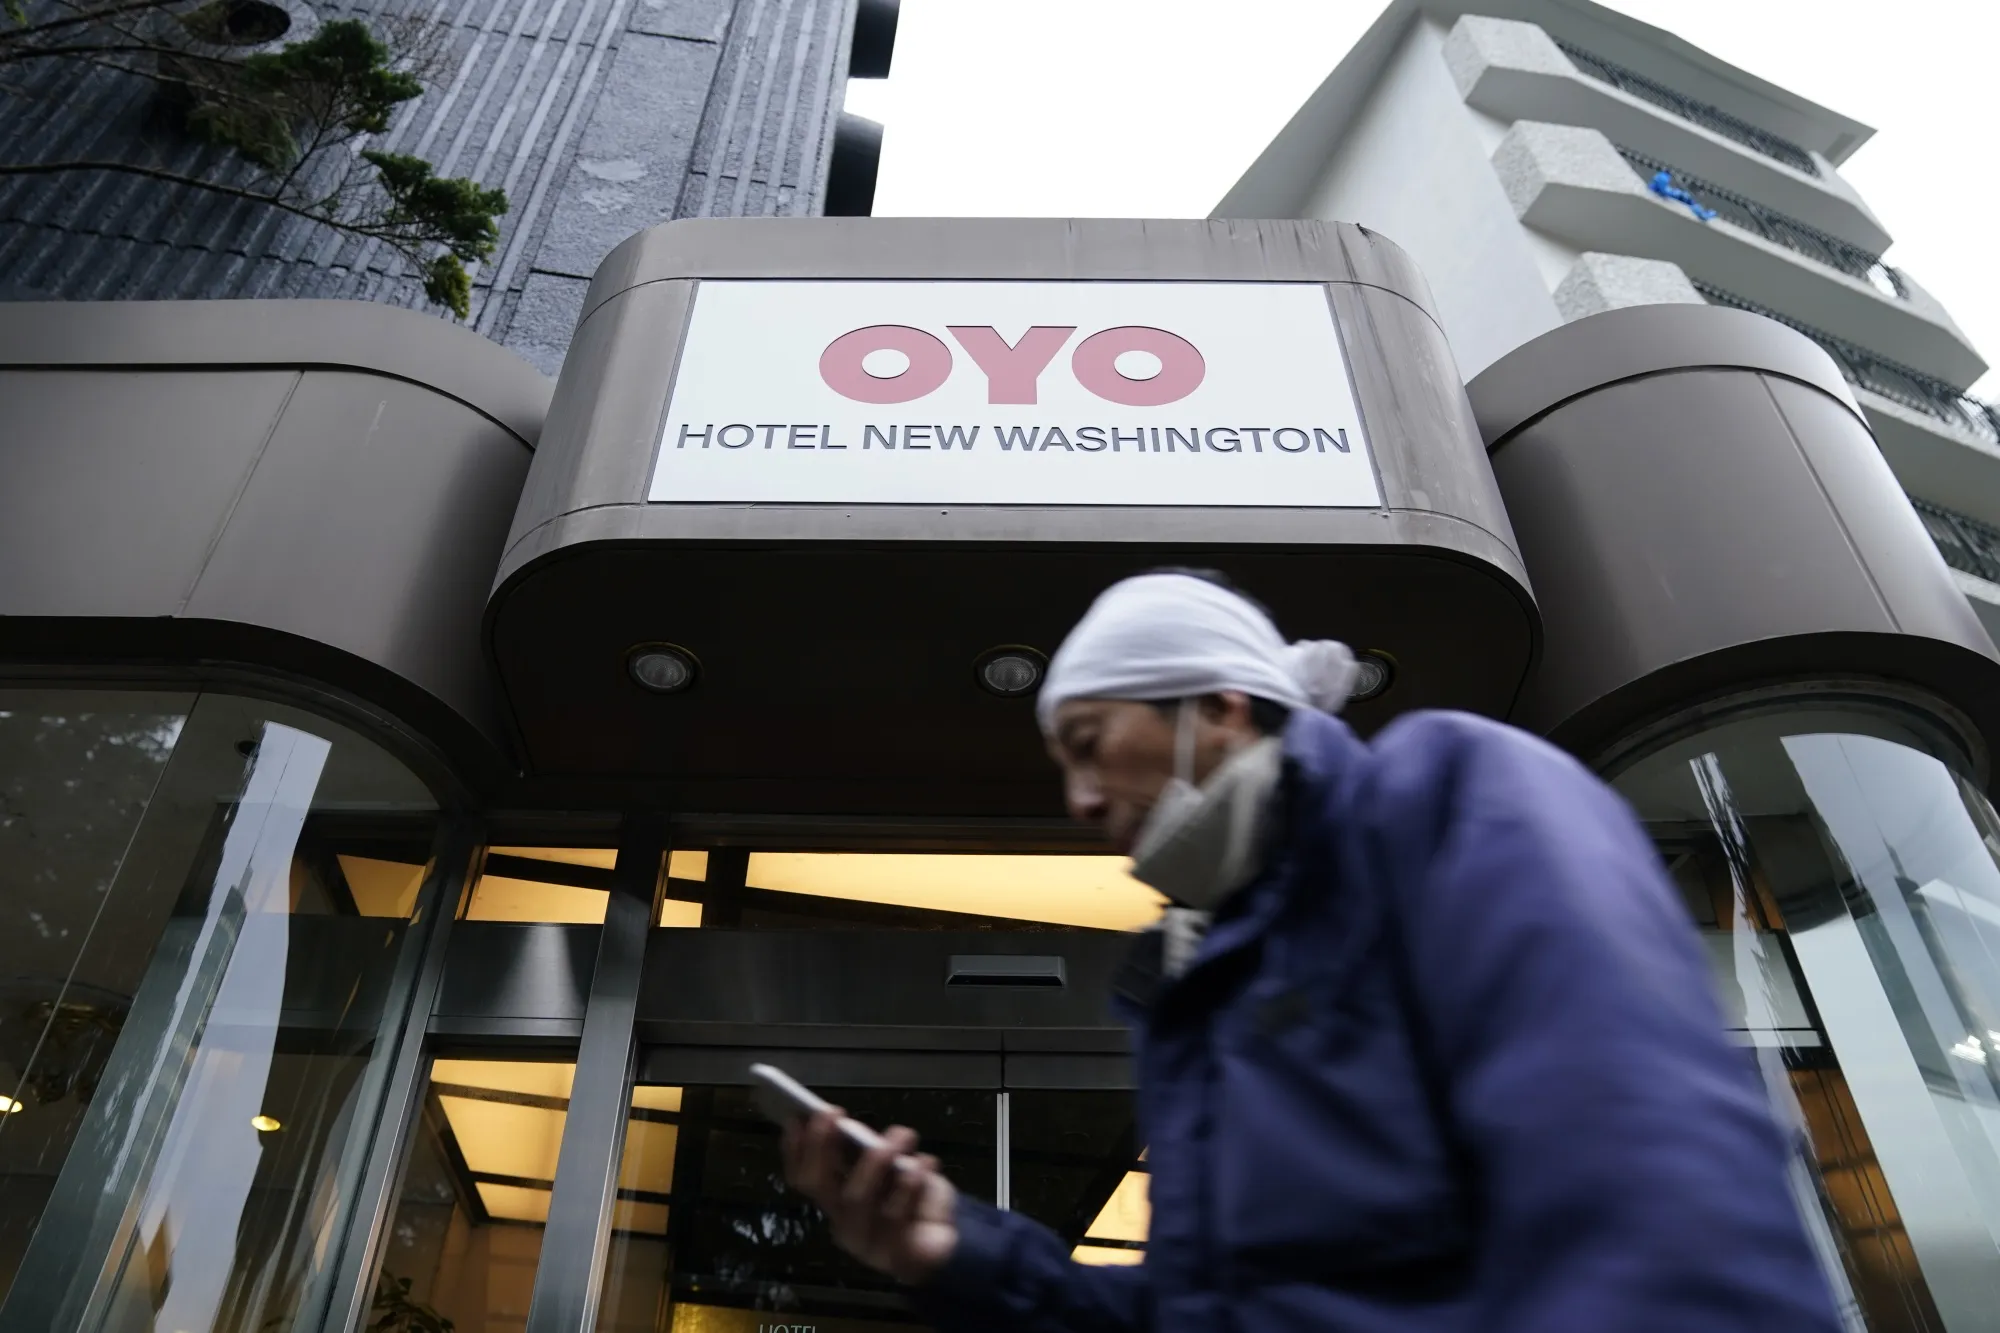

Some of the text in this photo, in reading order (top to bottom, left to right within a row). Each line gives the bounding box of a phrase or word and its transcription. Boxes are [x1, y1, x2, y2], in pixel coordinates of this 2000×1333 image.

[819, 324, 1205, 406] OYO
[677, 424, 1350, 453] HOTEL NEW WASHINGTON
